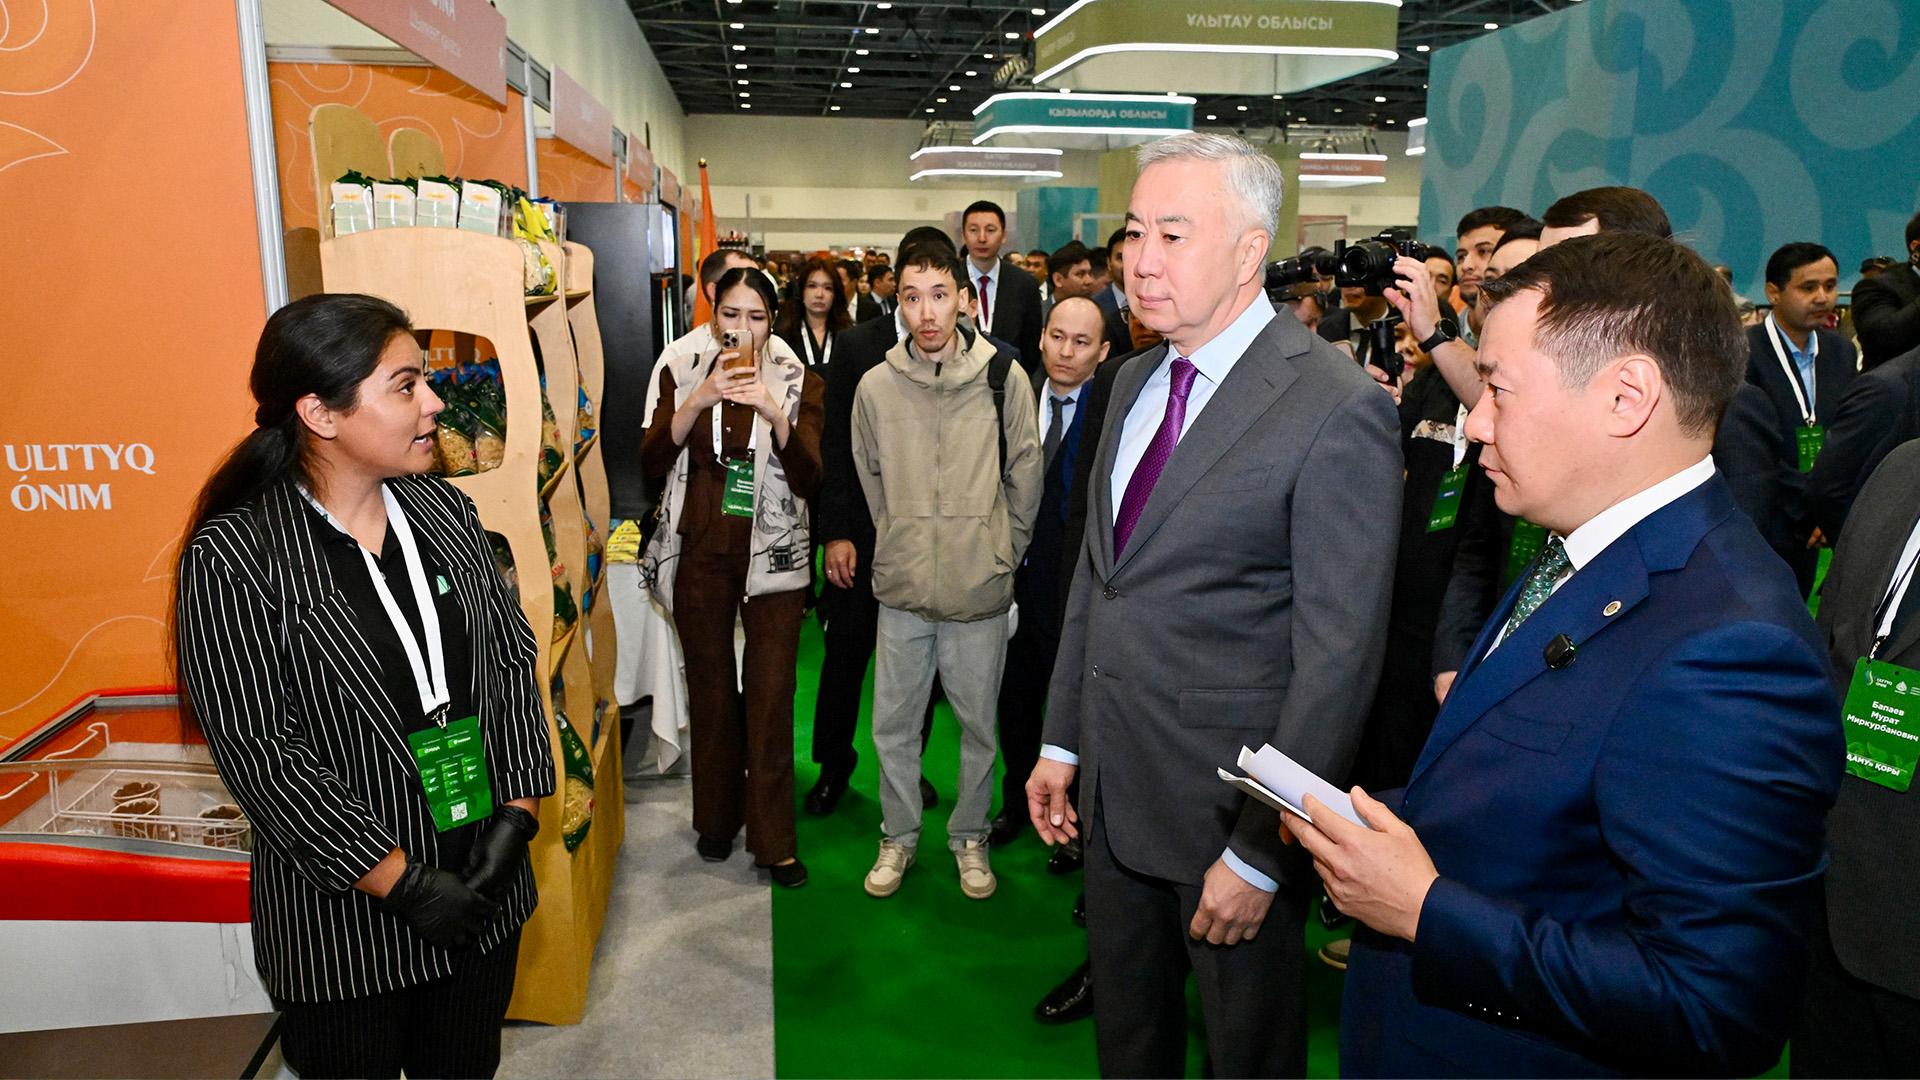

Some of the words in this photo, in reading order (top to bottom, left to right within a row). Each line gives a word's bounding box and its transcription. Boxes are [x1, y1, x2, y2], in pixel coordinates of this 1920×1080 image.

[1186, 13, 1252, 28] ҰЛЫТАУ
[1257, 15, 1333, 30] ОБЛЫСЫ
[1119, 109, 1167, 120] ОБЛЫСЫ
[4, 443, 156, 475] ULTTYQ
[10, 475, 112, 511] ÓNIM
[1871, 700, 1905, 717] Бапаев
[1870, 710, 1900, 726] Мурат
[1846, 713, 1919, 742] Миркурбанович
[1874, 762, 1900, 777] ҚОРЫ
